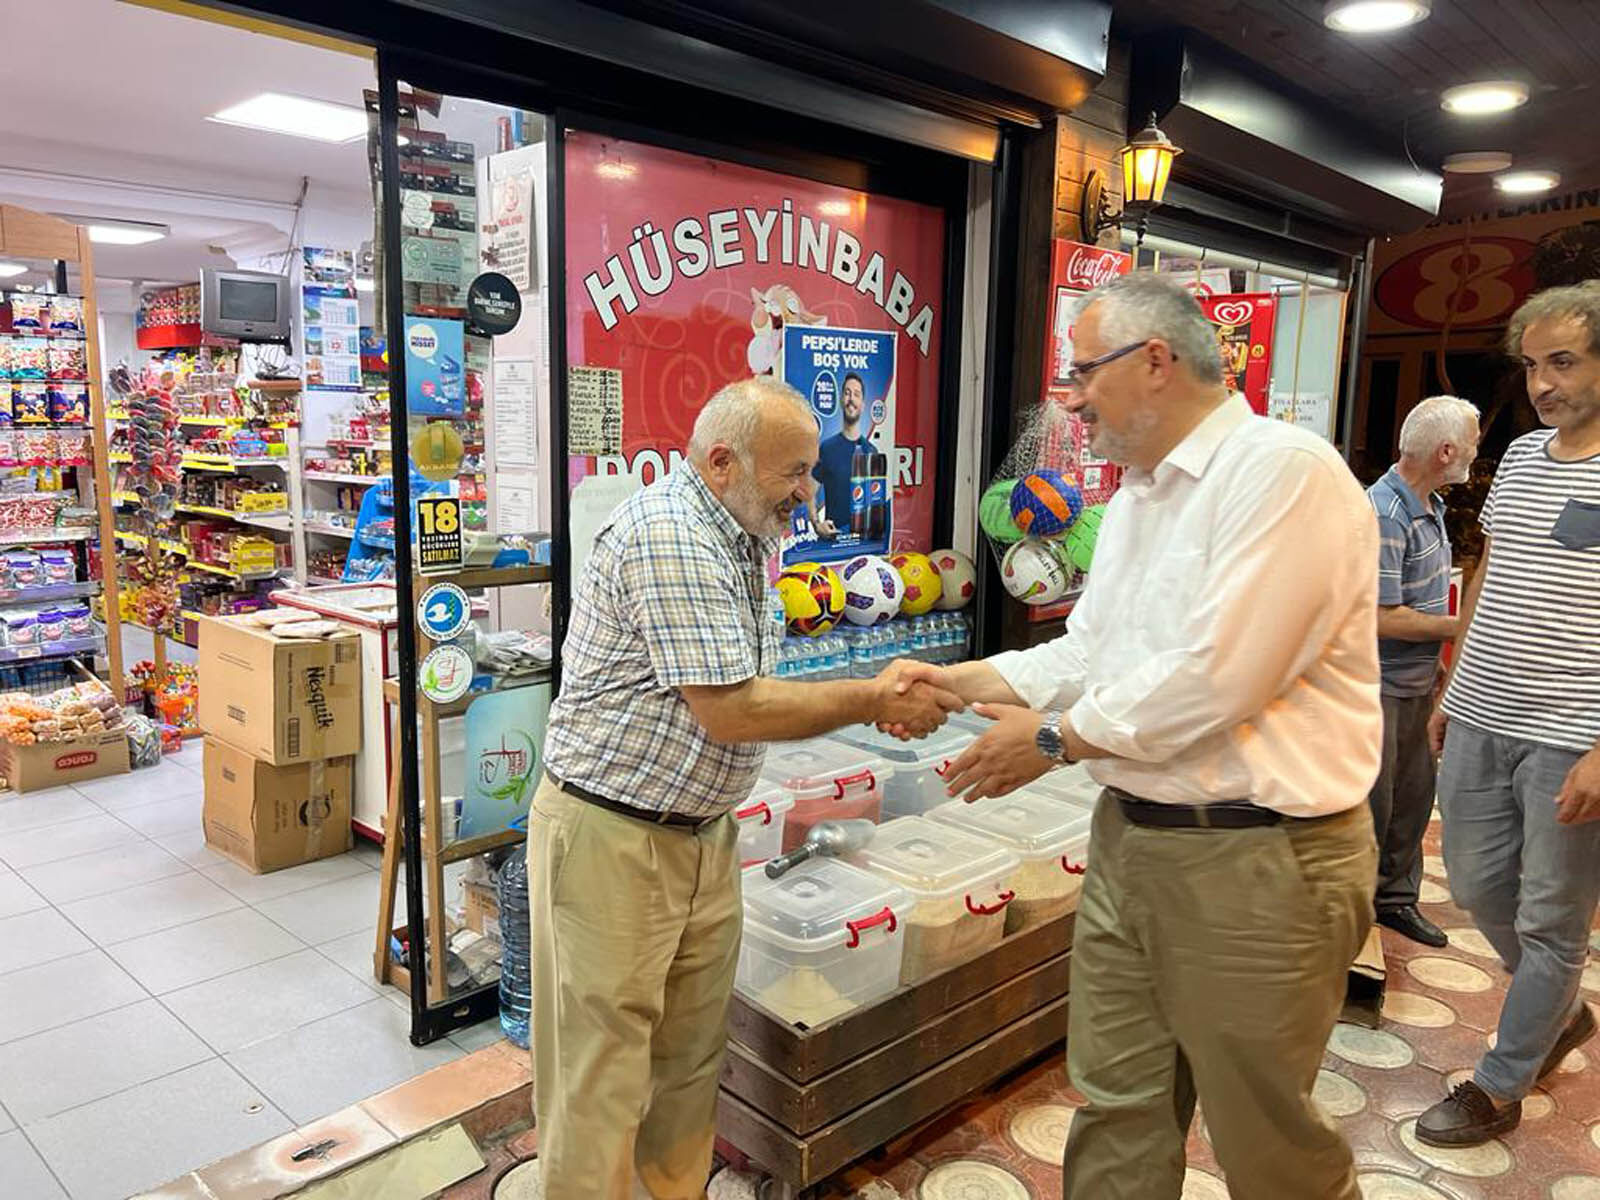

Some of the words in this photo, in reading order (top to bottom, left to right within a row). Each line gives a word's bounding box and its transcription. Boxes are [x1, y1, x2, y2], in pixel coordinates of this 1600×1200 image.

[583, 198, 935, 357] HÜSEYİNBABA
[813, 353, 840, 373] BOŞ
[842, 354, 869, 369] YOK
[419, 501, 459, 535] 18
[422, 548, 460, 564] SATILMAZ
[306, 665, 335, 731] Nesquik
